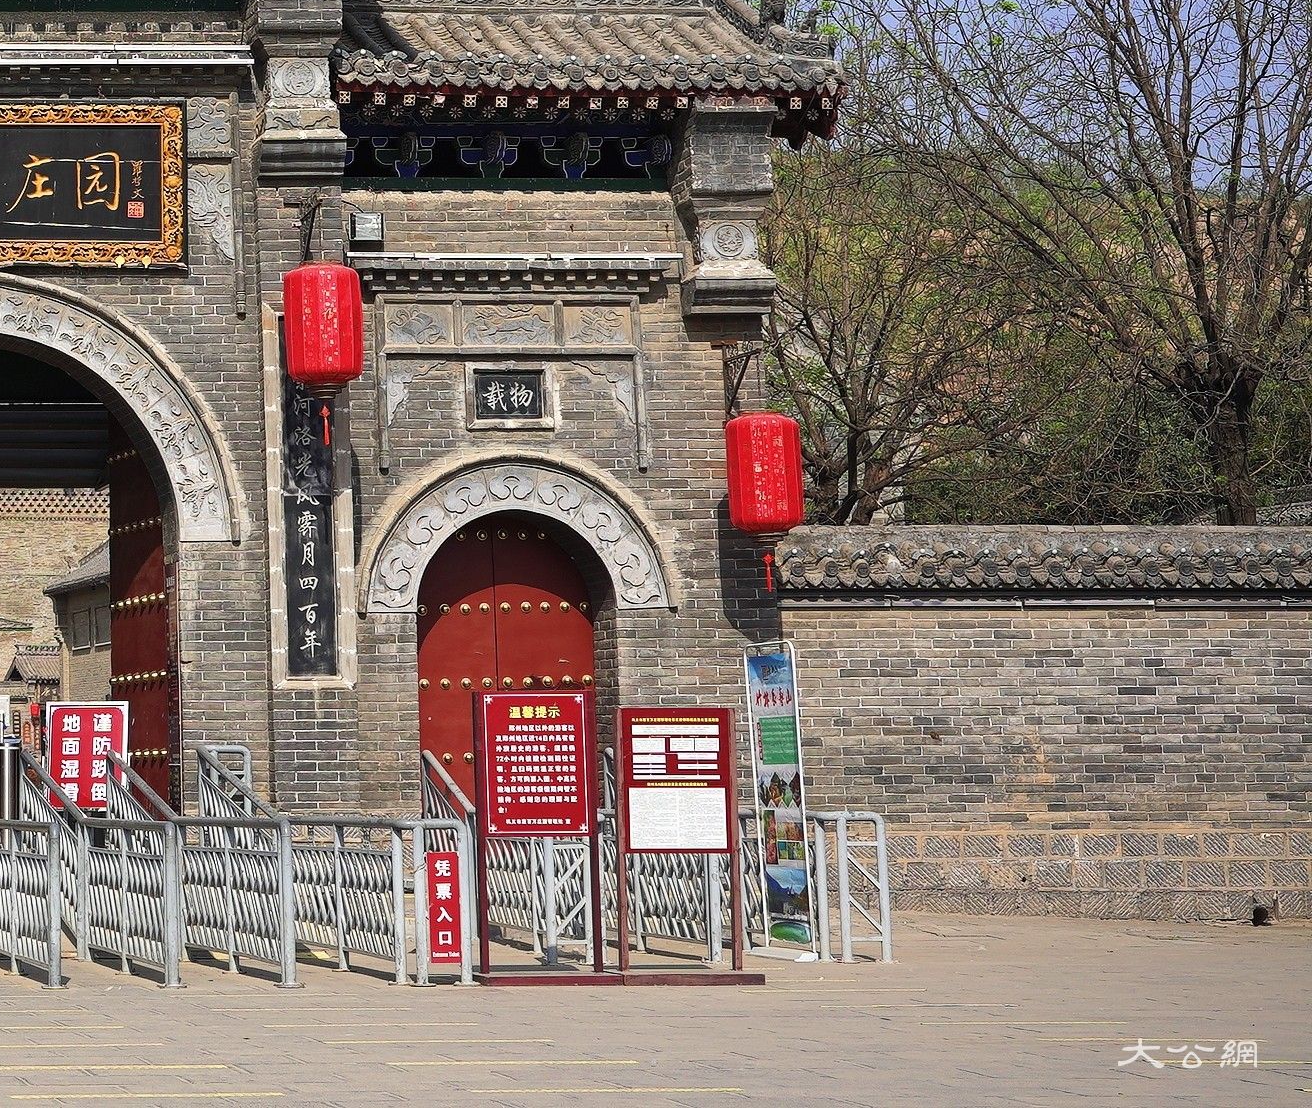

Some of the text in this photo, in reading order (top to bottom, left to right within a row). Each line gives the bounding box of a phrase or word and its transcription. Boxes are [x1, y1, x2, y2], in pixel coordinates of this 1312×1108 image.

[509, 705, 560, 719] 温馨提示
[60, 714, 81, 802] 地面湿滑
[90, 713, 112, 802] 谨防跌倒
[434, 859, 453, 946] 凭票入口
